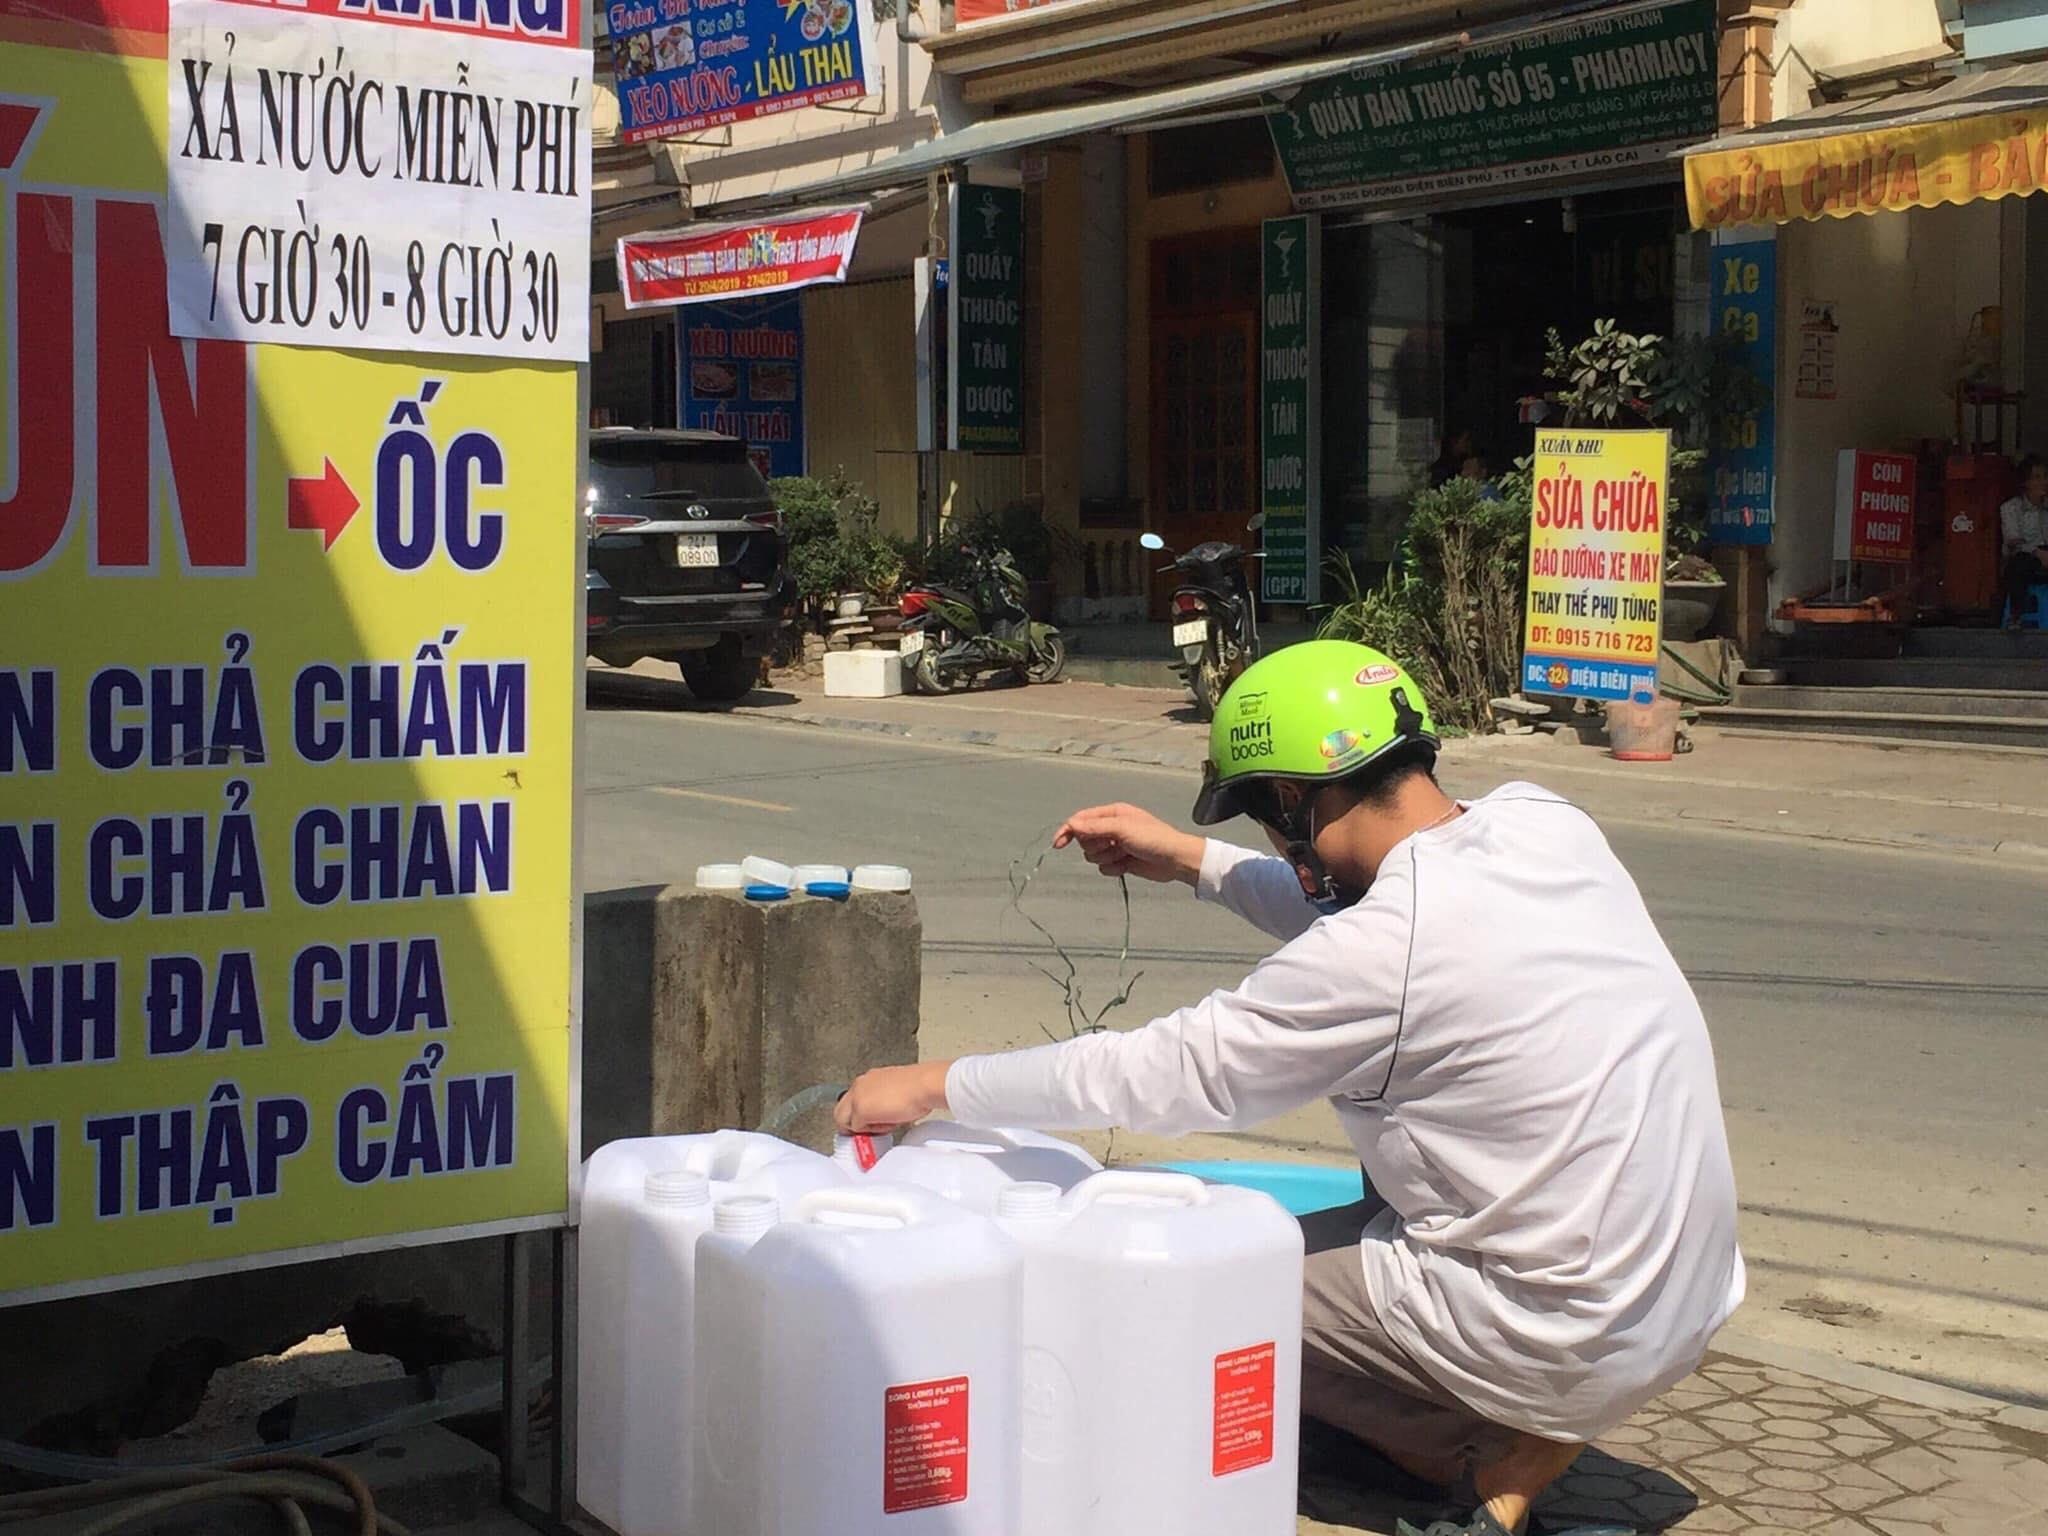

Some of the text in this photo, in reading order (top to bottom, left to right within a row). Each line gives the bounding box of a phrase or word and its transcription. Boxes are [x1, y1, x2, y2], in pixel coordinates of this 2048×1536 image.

[754, 32, 797, 100] LẨU
[1364, 83, 1414, 129] BÁN
[1411, 63, 1486, 120] THUỐC
[1487, 54, 1522, 108] SỐ
[1522, 62, 1556, 103] 95
[1571, 32, 1709, 94] PHARMACY
[180, 31, 580, 197] XẢ NƯỚC MIỄN PHÍ
[1704, 154, 1787, 224] SỬA
[202, 222, 224, 322] 7
[236, 200, 320, 328] GIỜ
[329, 232, 371, 332] 30
[406, 240, 426, 335] 8
[438, 218, 515, 341] GIỜ
[522, 248, 559, 344] 30
[1723, 257, 1761, 295] Xe
[960, 293, 1019, 326] THUỐC
[972, 338, 1007, 369] TÂN
[1271, 397, 1298, 436] TÂN
[376, 381, 505, 570] ỐC
[1536, 461, 1660, 533] SỬA CHỮA
[1861, 489, 1910, 514] PHÒNG
[1533, 539, 1660, 584] BẢO DƯỠNG XE MÁY
[1531, 587, 1657, 625] THAY THẾ PHỤ TÙNG
[1532, 625, 1653, 652] ĐT: 0915 716 723
[89, 632, 265, 768] CHẢ
[294, 630, 526, 762] CHẤM
[1547, 667, 1570, 685] 324
[1571, 666, 1599, 690] ĐIỆN
[1600, 668, 1628, 690] BIÊN
[1230, 738, 1275, 761] boost
[89, 780, 265, 919] CHẢ
[295, 802, 510, 905] CHAN
[147, 952, 263, 1055] ĐA
[293, 939, 447, 1042] CUA
[88, 1083, 308, 1224] THẬP
[338, 1043, 513, 1183] CẨM
